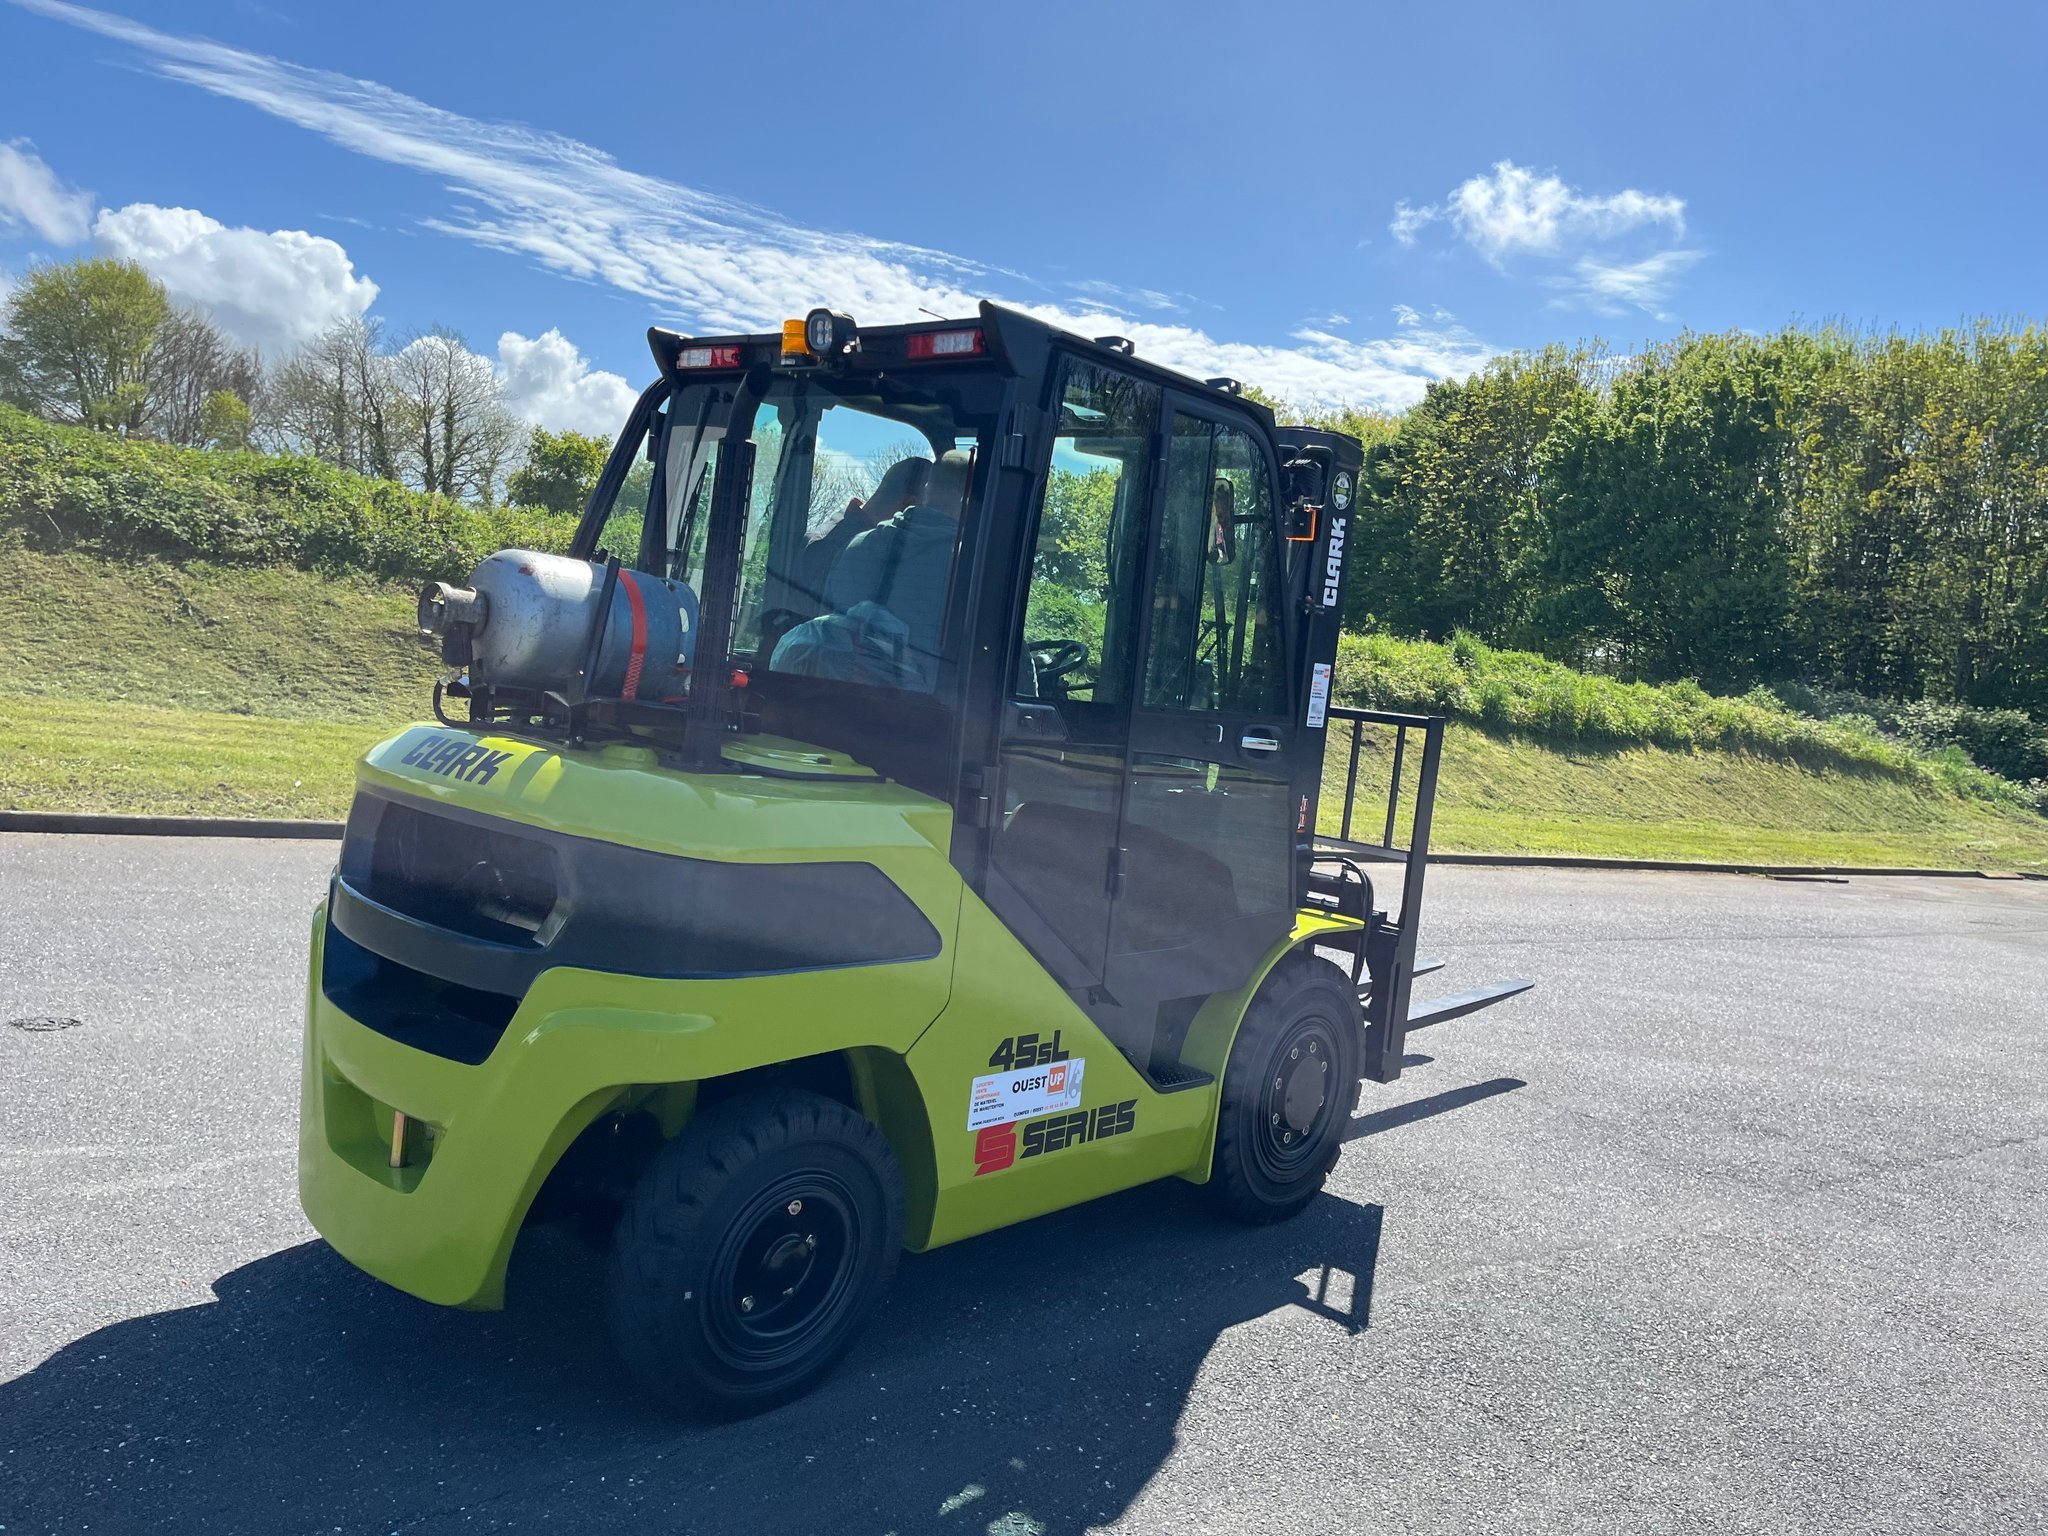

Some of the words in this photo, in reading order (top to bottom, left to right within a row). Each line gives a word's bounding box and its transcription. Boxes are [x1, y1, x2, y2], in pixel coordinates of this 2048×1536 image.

[1322, 517, 1346, 607] CLARK
[401, 735, 514, 786] CLARK
[1012, 1075, 1048, 1094] OUEST
[1049, 1072, 1065, 1087] UP
[973, 1121, 1018, 1177] S
[1019, 1099, 1139, 1160] SERIES
